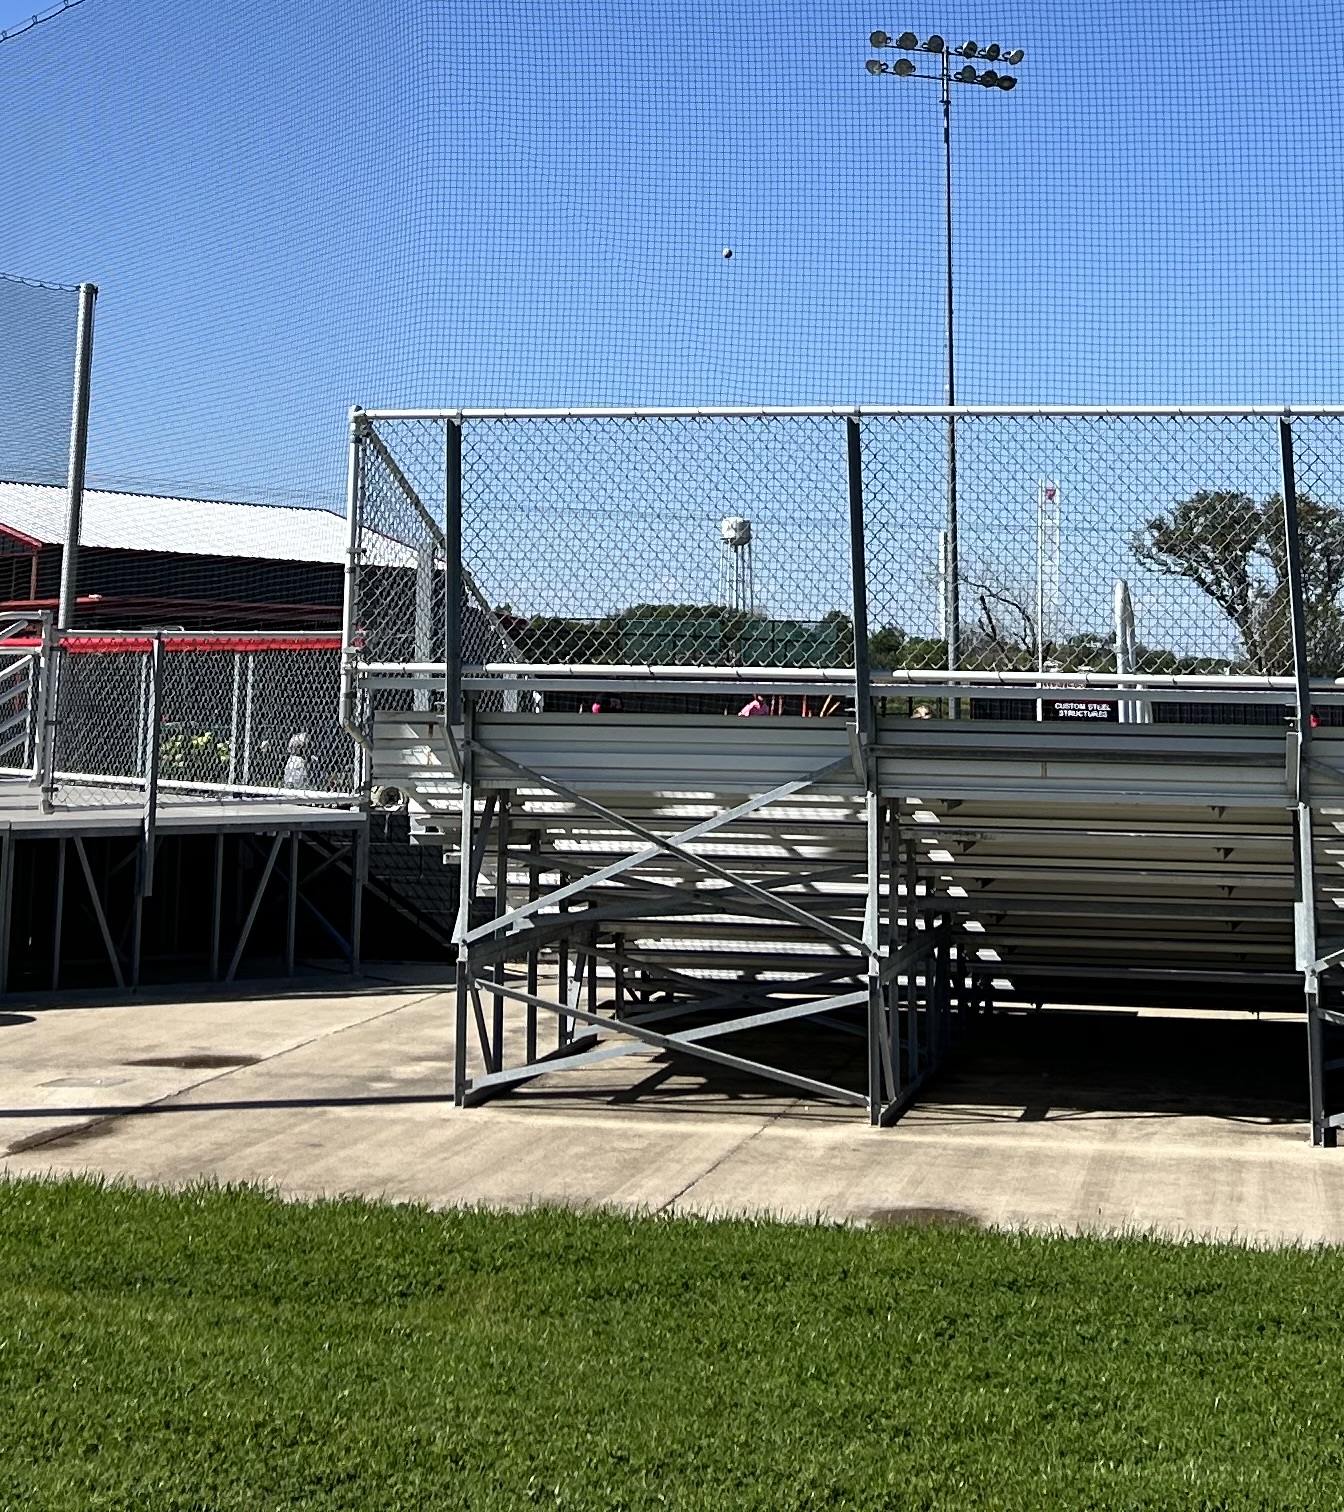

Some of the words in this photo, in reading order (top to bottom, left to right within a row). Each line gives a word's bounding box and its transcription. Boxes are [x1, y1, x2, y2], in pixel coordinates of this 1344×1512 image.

[1054, 702, 1086, 710] CUSTOM
[1087, 703, 1111, 711] STEEL
[1059, 710, 1108, 718] STRUCTURES
